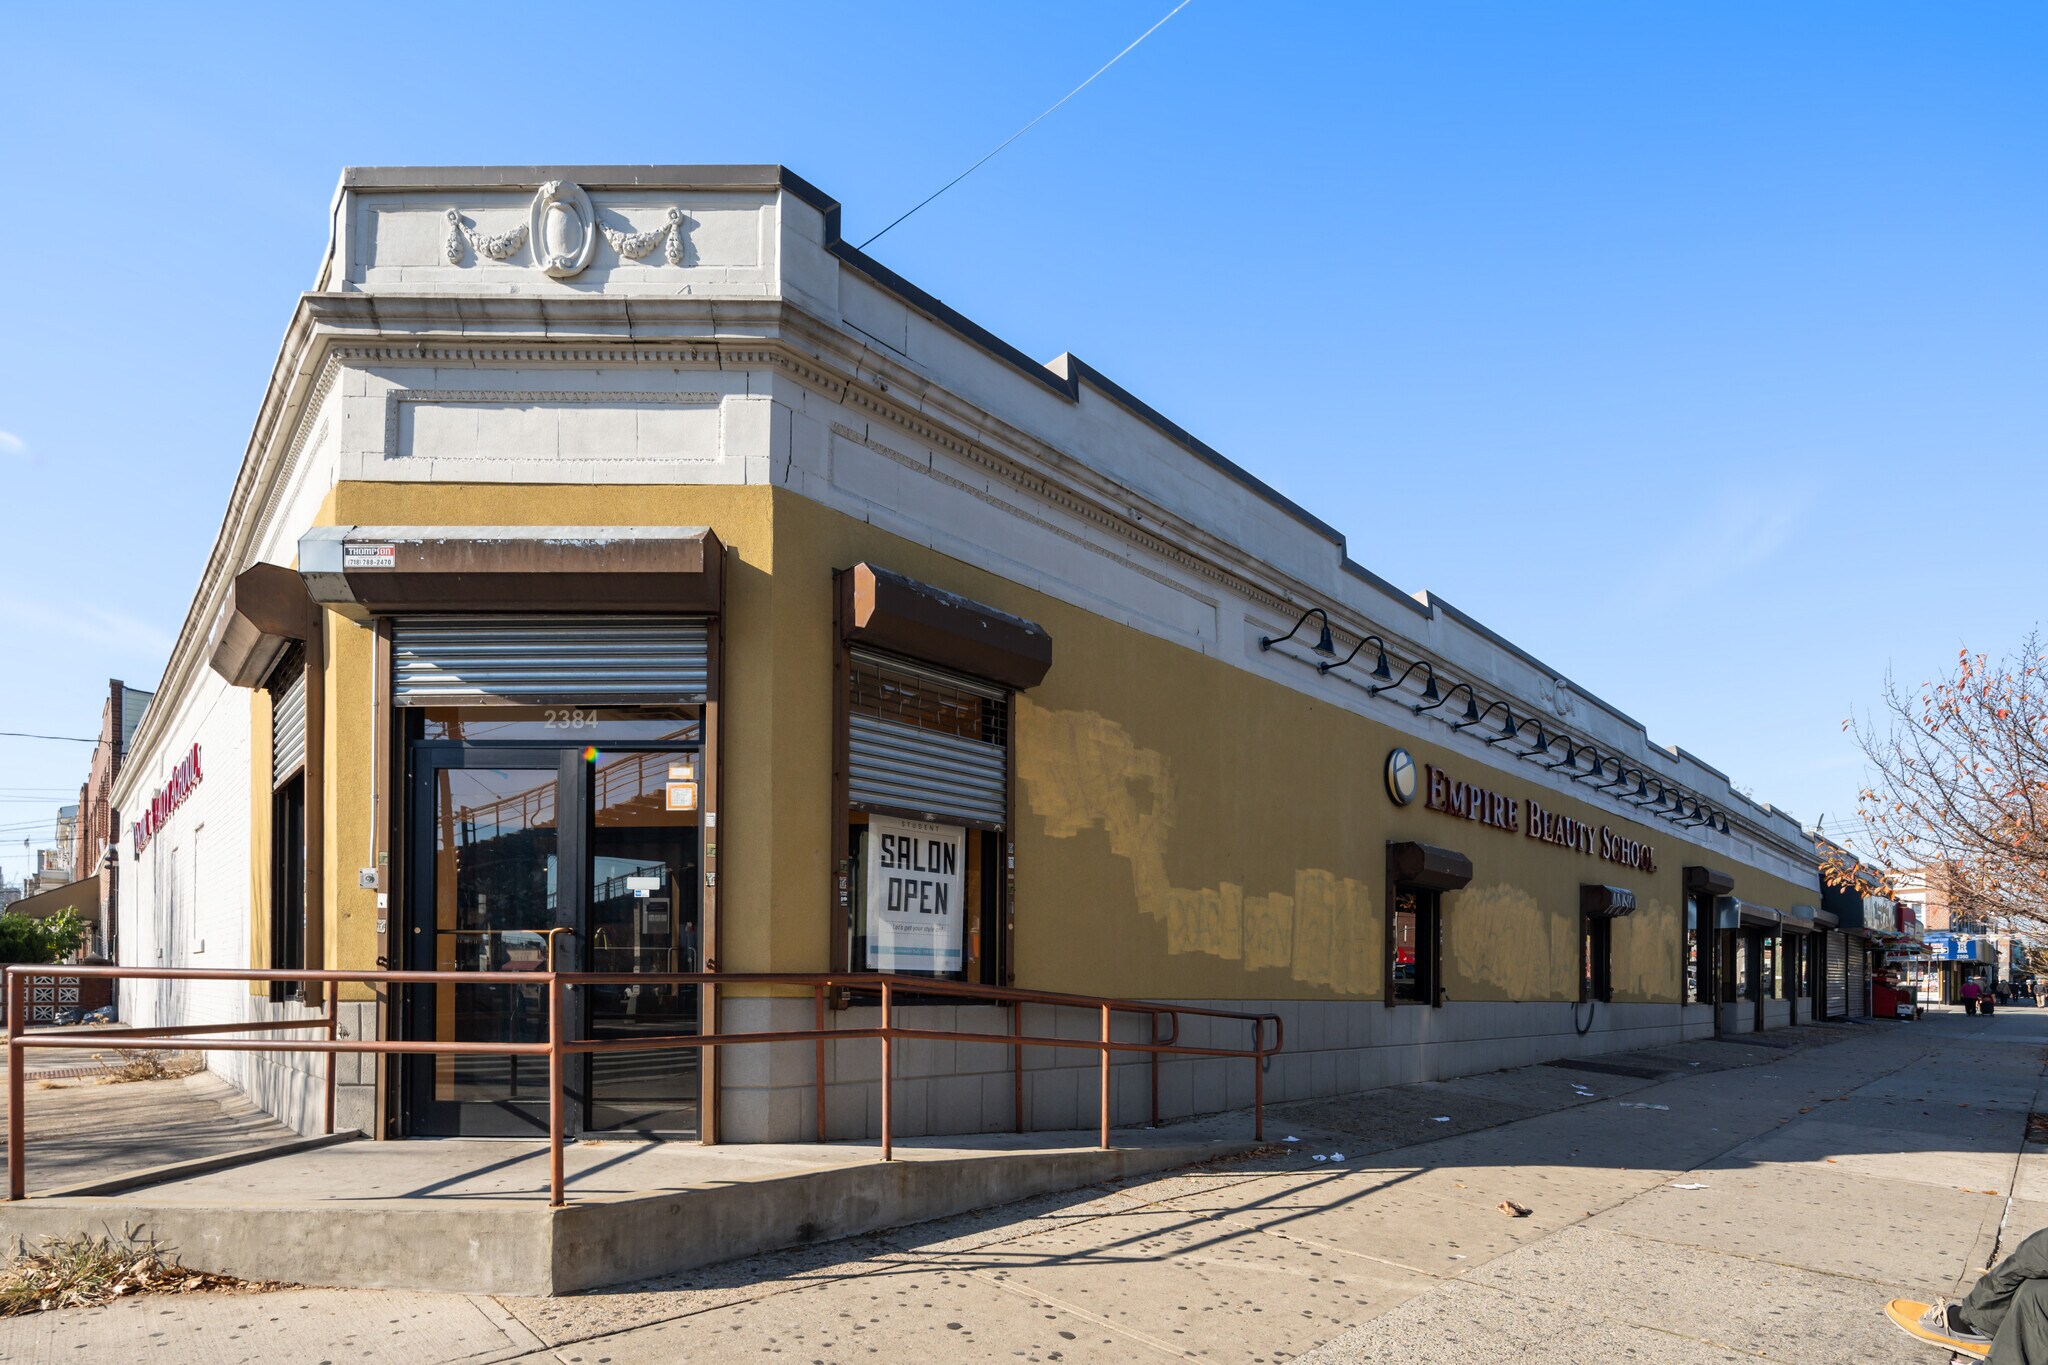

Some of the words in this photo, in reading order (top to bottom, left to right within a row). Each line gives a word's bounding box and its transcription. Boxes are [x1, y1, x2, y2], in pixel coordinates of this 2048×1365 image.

[543, 709, 599, 730] 2384
[901, 821, 939, 832] STUDENT
[1425, 763, 1519, 833] EMPIRE
[1525, 799, 1597, 855] BEAUTY
[1600, 824, 1657, 874] SCHOOL
[881, 833, 956, 875] SALON
[887, 877, 948, 915] OPEN
